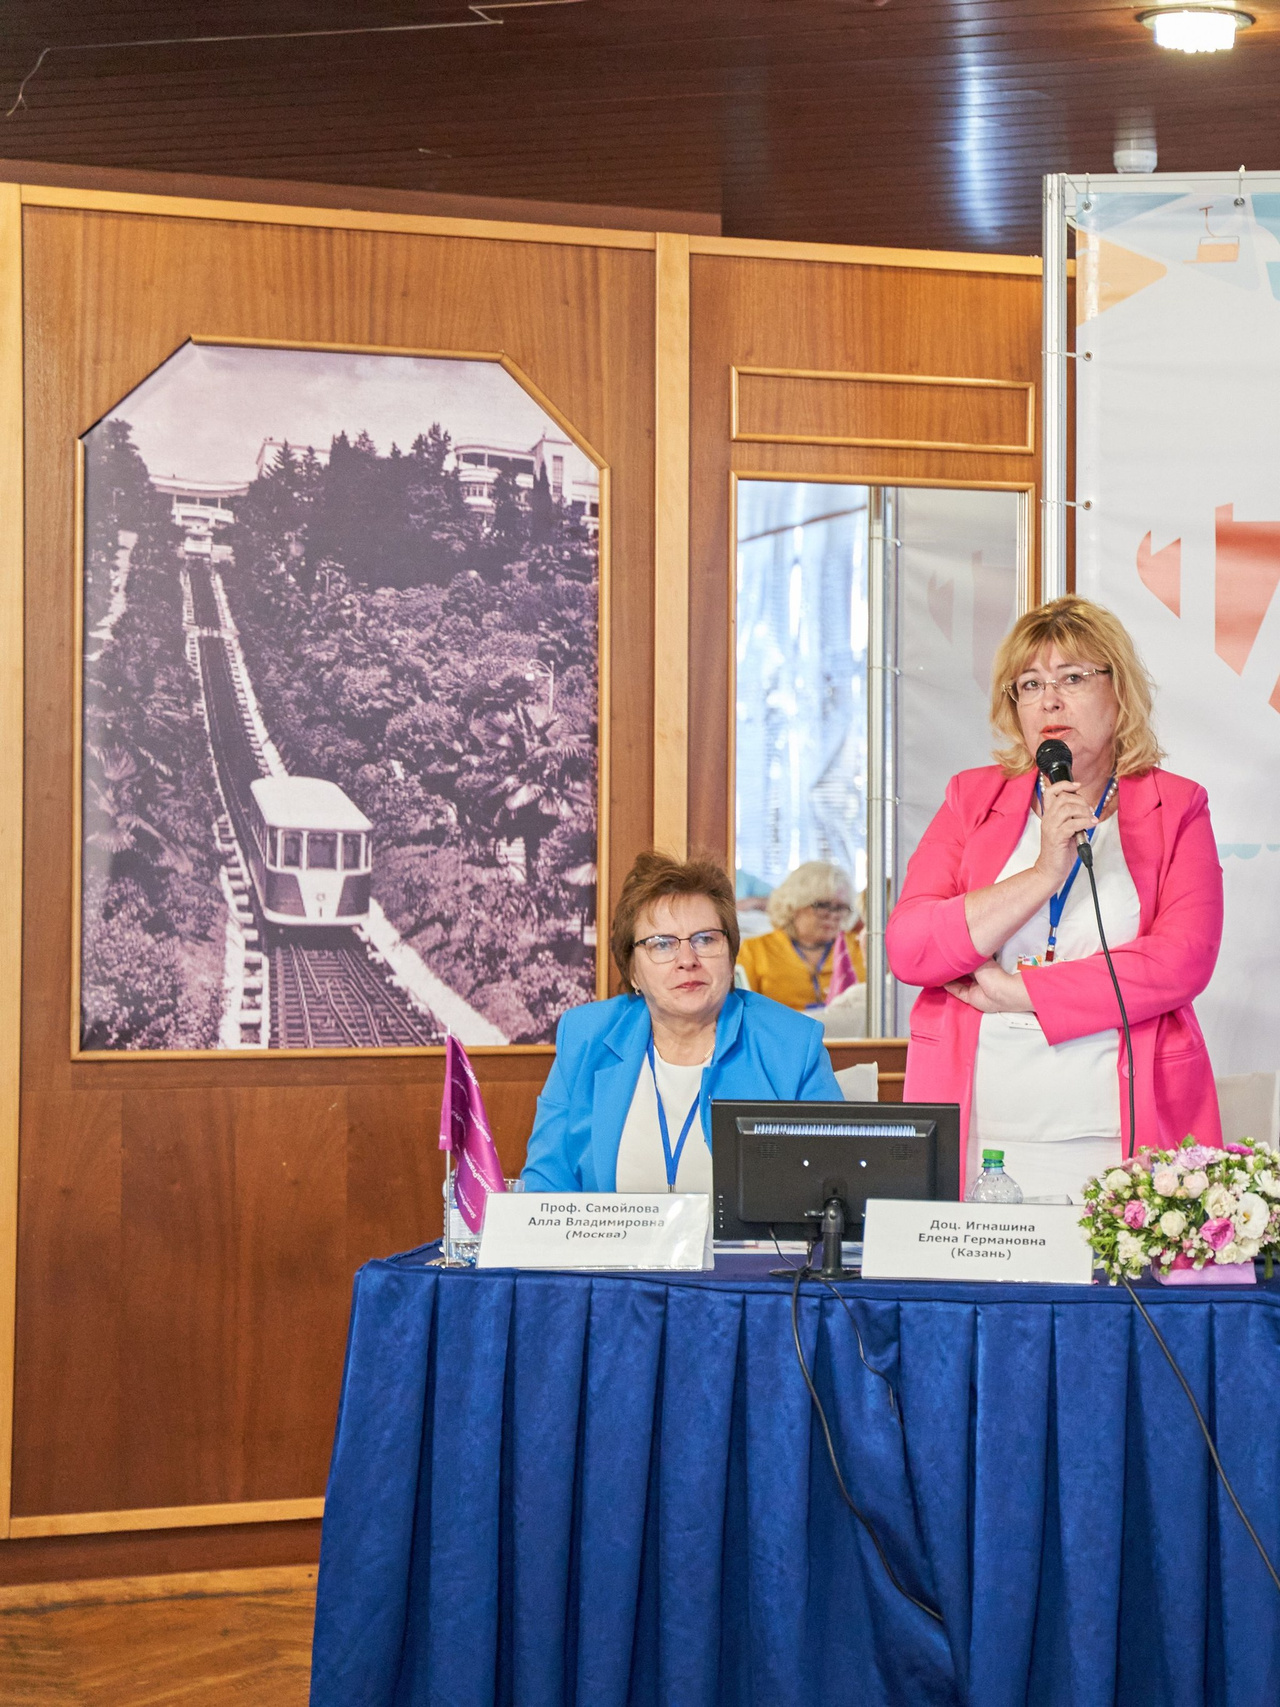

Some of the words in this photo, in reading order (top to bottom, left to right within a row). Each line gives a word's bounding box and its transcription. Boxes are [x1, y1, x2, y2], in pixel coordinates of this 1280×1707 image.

[540, 1202, 581, 1216] Проф.
[586, 1201, 660, 1214] Самойлова
[527, 1216, 561, 1228] Алла
[566, 1217, 665, 1229] Владимировна
[929, 1219, 962, 1231] Доц.
[966, 1221, 1036, 1233] Игнашина
[565, 1229, 628, 1241] (Москва)
[918, 1232, 959, 1244] Елена
[963, 1234, 1047, 1247] Германовна
[950, 1247, 1012, 1261] (Казань)
